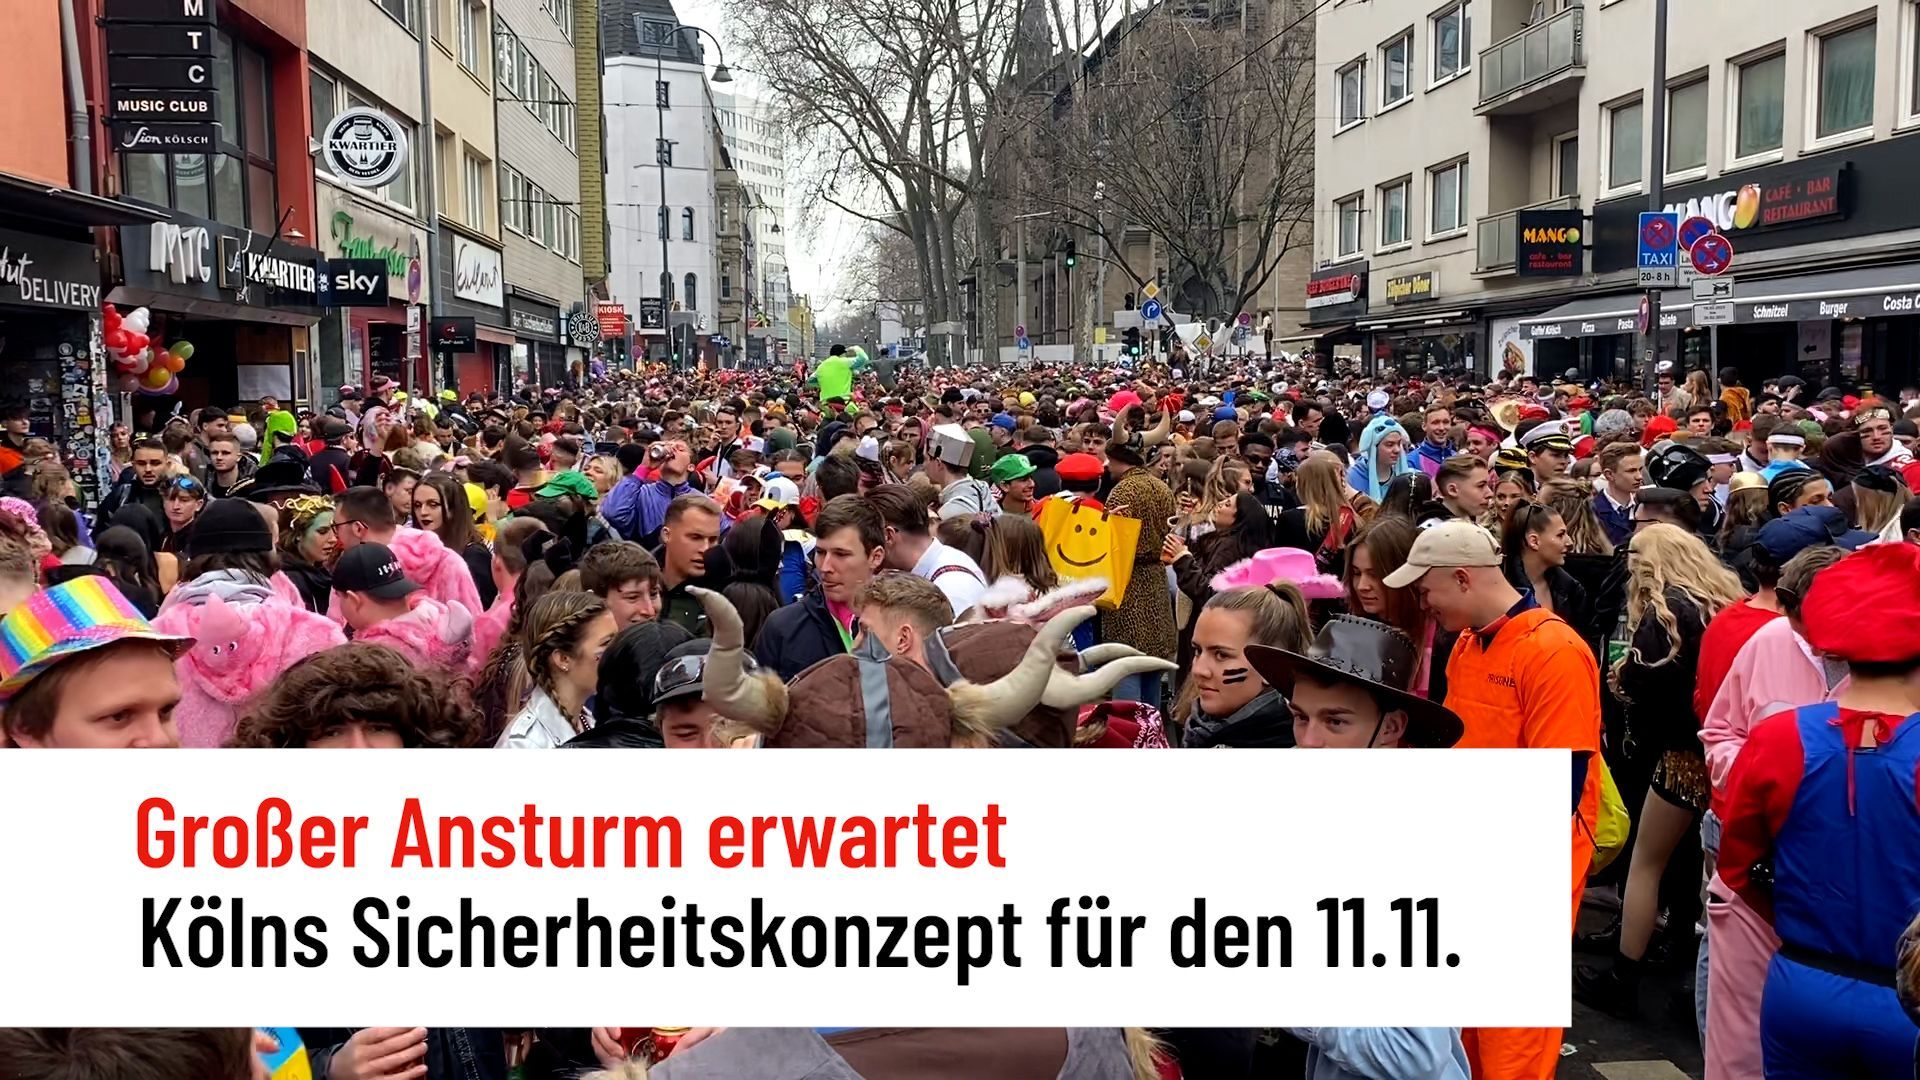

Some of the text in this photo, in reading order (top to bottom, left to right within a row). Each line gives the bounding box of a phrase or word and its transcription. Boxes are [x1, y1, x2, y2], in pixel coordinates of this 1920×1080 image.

[117, 100, 208, 112] MUSIC CLUB
[122, 126, 208, 147] Sion KÖLSCH
[329, 140, 397, 151] KWARTIER
[1766, 176, 1831, 202] CAFÉ BAR
[1763, 196, 1835, 222] RESTAURANT
[1523, 227, 1580, 244] MANGO
[150, 221, 211, 284] MTC
[1557, 252, 1572, 260] bar
[1642, 252, 1673, 265] TAXI
[1528, 260, 1572, 268] restaurant
[249, 252, 316, 293] KWARTIER
[1664, 272, 1670, 281] h
[335, 269, 379, 296] sky
[20, 276, 100, 308] DELIVERY
[598, 305, 623, 313] KIOSK
[1753, 303, 1789, 319] Schnitzel
[1819, 301, 1848, 318] Burger
[1883, 296, 1912, 311] Costa
[1581, 321, 1595, 333] Pizza
[1617, 318, 1634, 330] Pasta
[1264, 504, 1284, 519] WAT
[1487, 673, 1517, 689] PRISONE
